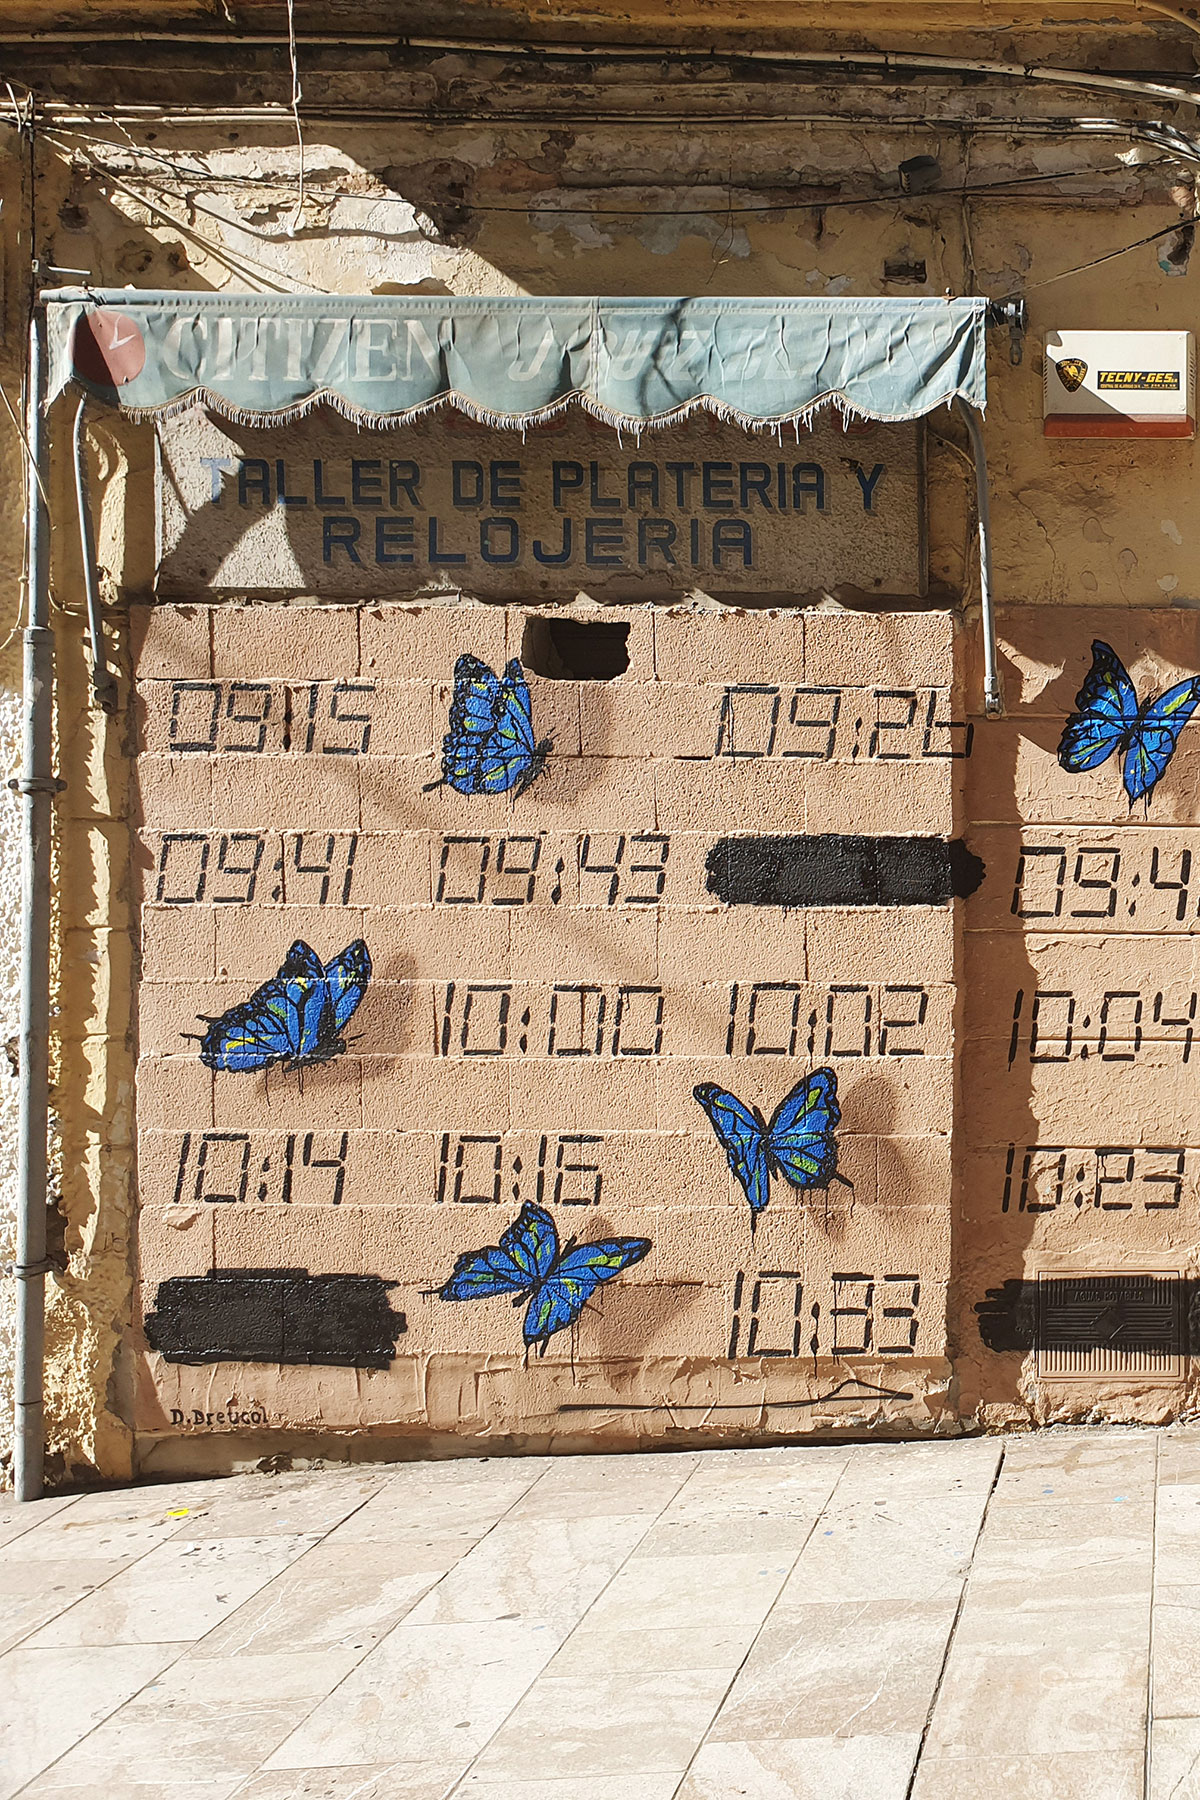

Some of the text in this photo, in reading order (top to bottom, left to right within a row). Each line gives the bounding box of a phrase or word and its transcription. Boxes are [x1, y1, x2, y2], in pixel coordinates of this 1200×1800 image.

[163, 316, 450, 382] CITIZEN
[1100, 372, 1174, 383] TECNY-GES
[200, 457, 884, 512] TALLER DE PLATERIA Y
[322, 516, 756, 566] RELOJERIA
[169, 682, 376, 755] 09:15
[715, 685, 974, 758] 09:26
[157, 833, 358, 905] 09:41
[436, 835, 671, 906] 09:43
[440, 982, 665, 1057] 10:00
[726, 982, 929, 1057] 10:02
[1007, 989, 1198, 1064] 10:04
[173, 1130, 349, 1205] 10:14
[436, 1131, 604, 1206] 10:16
[1001, 1142, 1186, 1213] 10:23
[727, 1269, 921, 1361] 10:33
